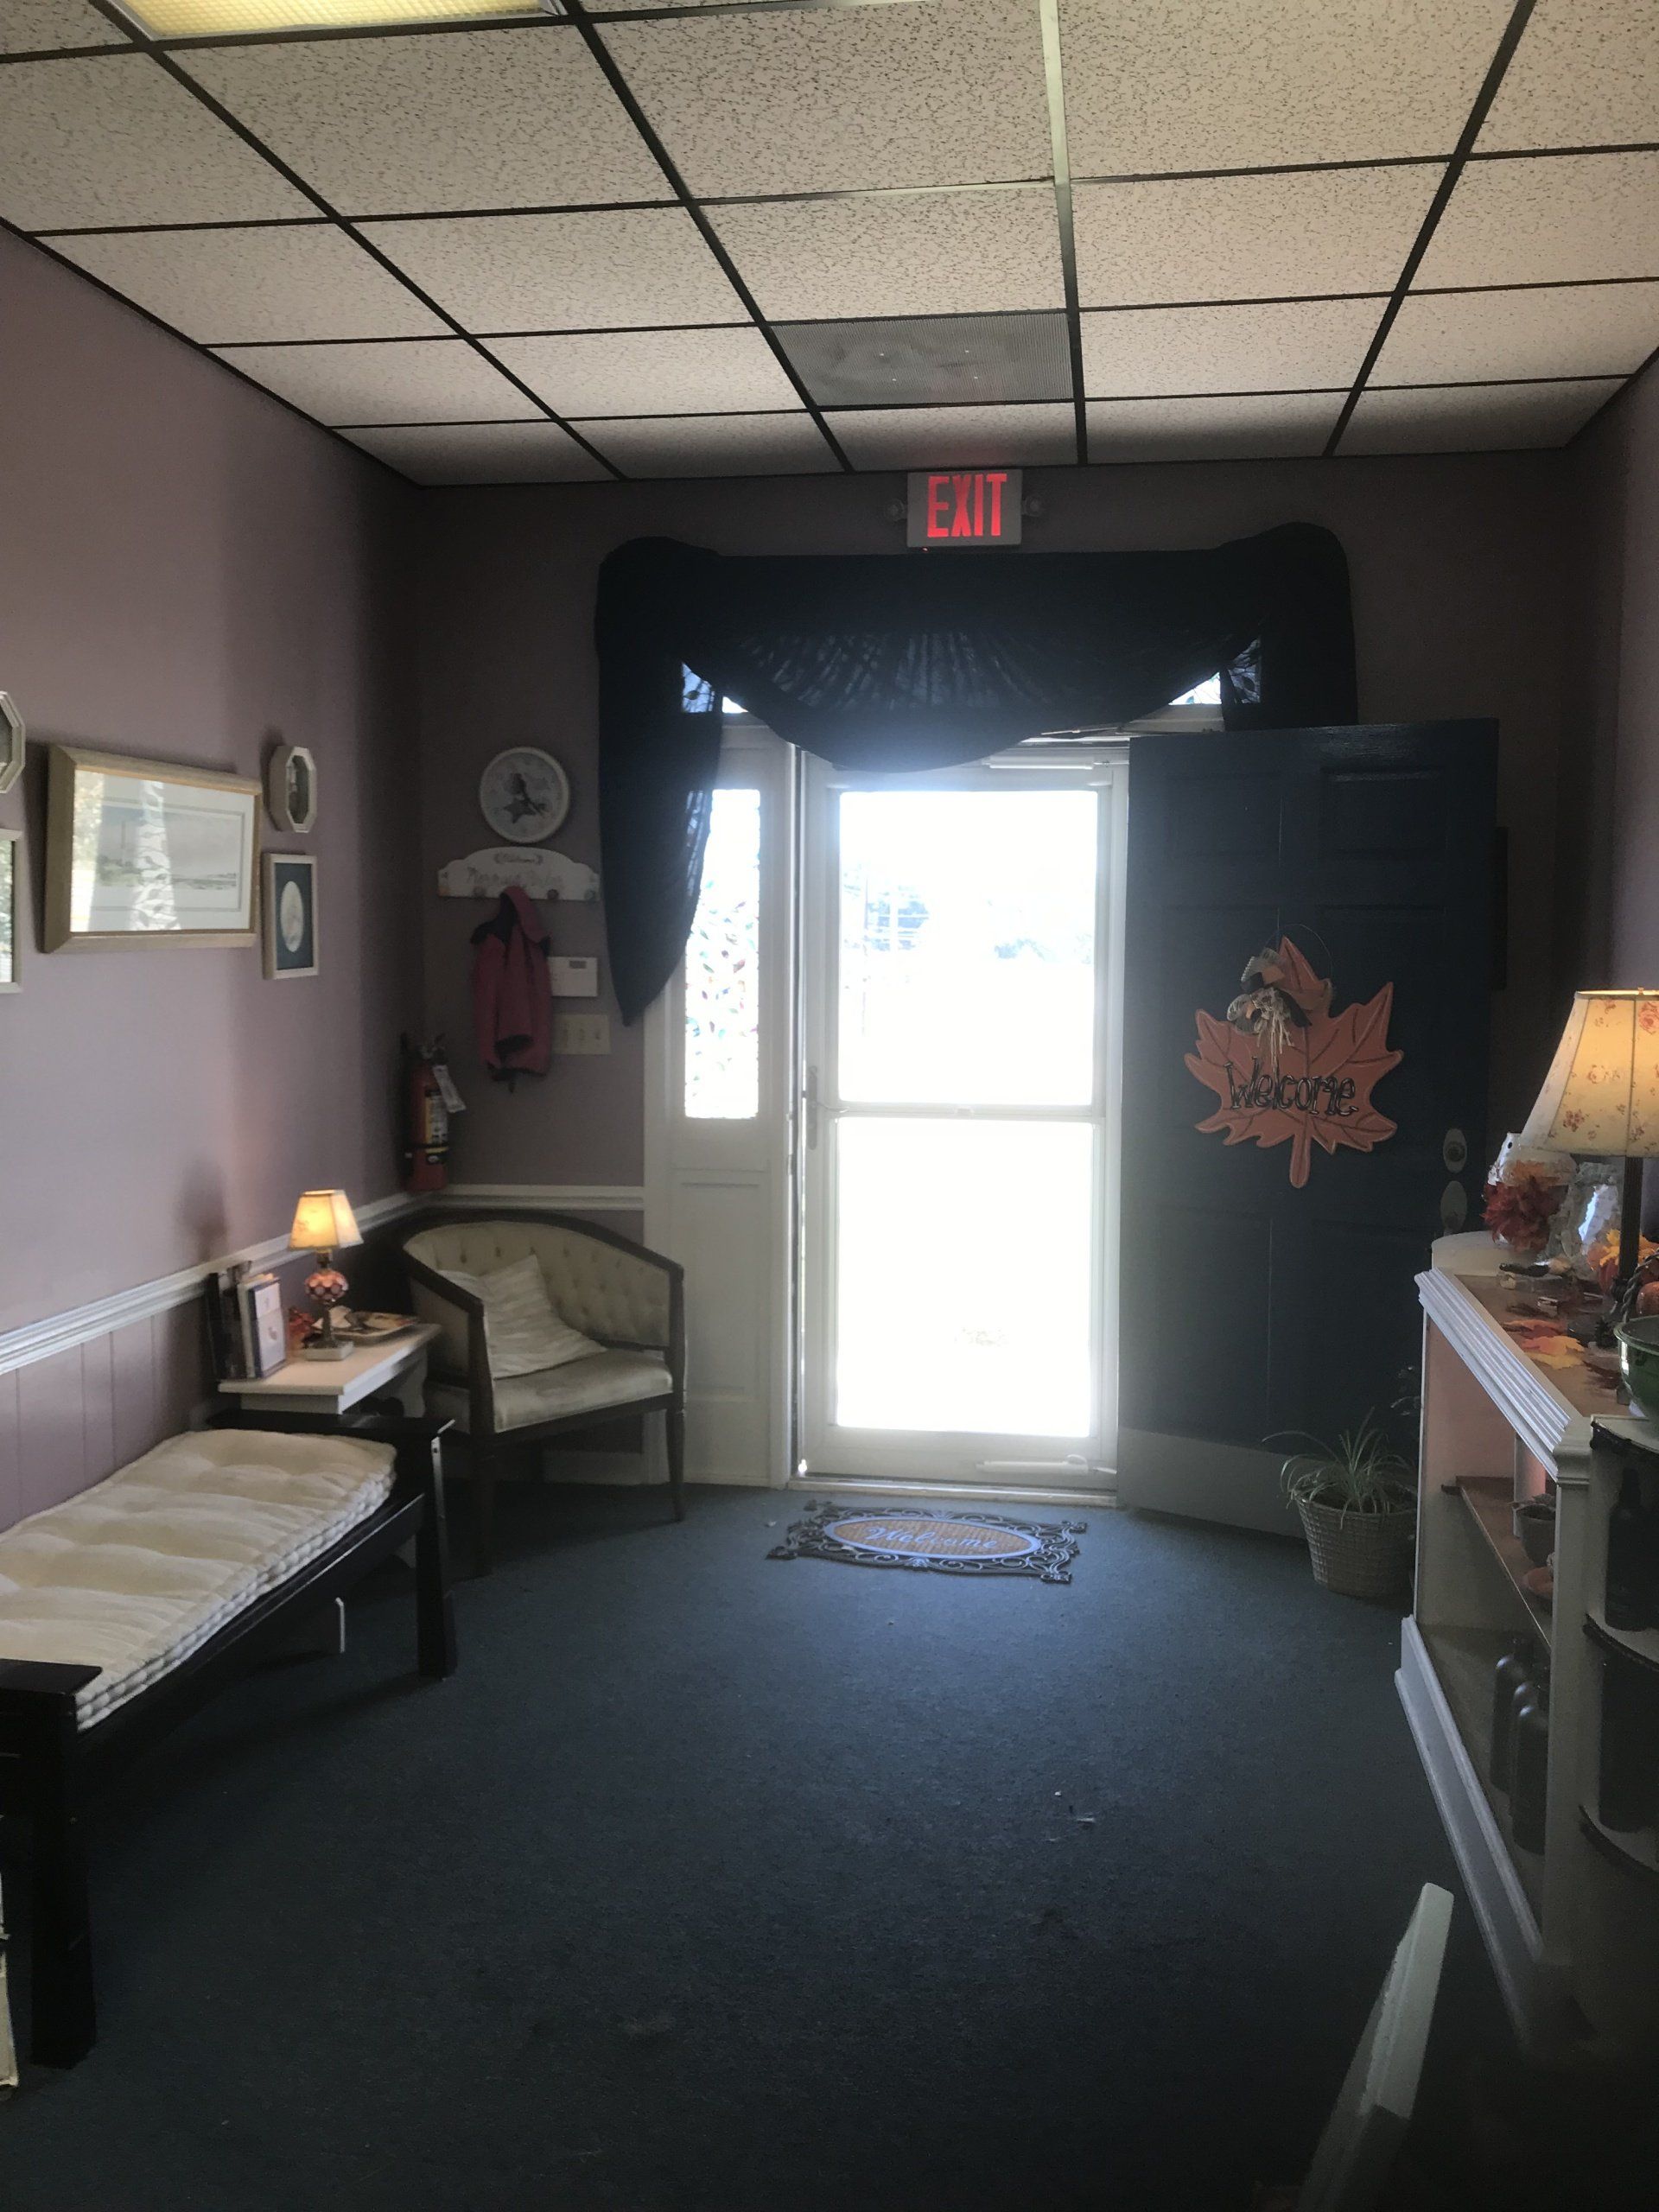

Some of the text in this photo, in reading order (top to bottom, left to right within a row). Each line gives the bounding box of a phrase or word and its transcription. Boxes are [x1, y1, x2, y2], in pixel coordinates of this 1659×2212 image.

[927, 474, 1007, 537] EXIT
[1224, 1058, 1359, 1116] Welcome
[865, 1527, 997, 1549] Welcome
